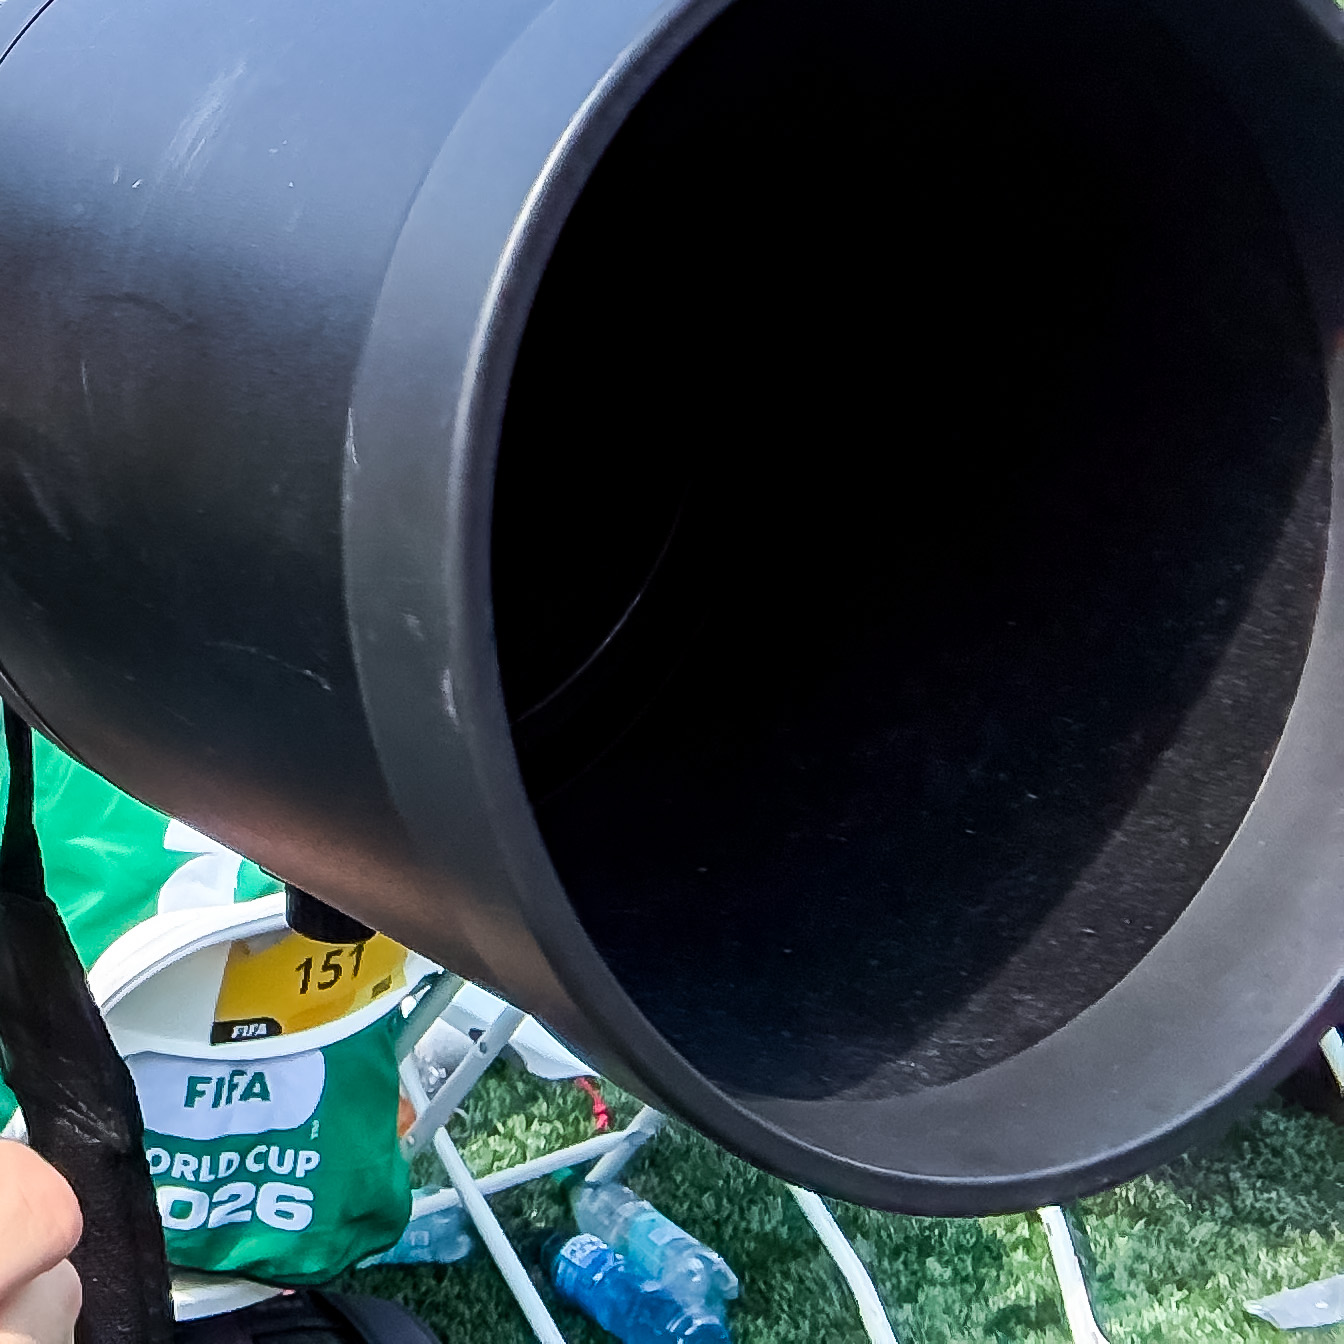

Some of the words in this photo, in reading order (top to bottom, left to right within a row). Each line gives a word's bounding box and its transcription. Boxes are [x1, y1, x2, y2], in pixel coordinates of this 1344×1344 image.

[295, 941, 367, 995] 151
[184, 1069, 272, 1110] FIFA
[147, 1151, 241, 1182] ORLD
[245, 1144, 320, 1179] CUP
[159, 1181, 314, 1232] 026
